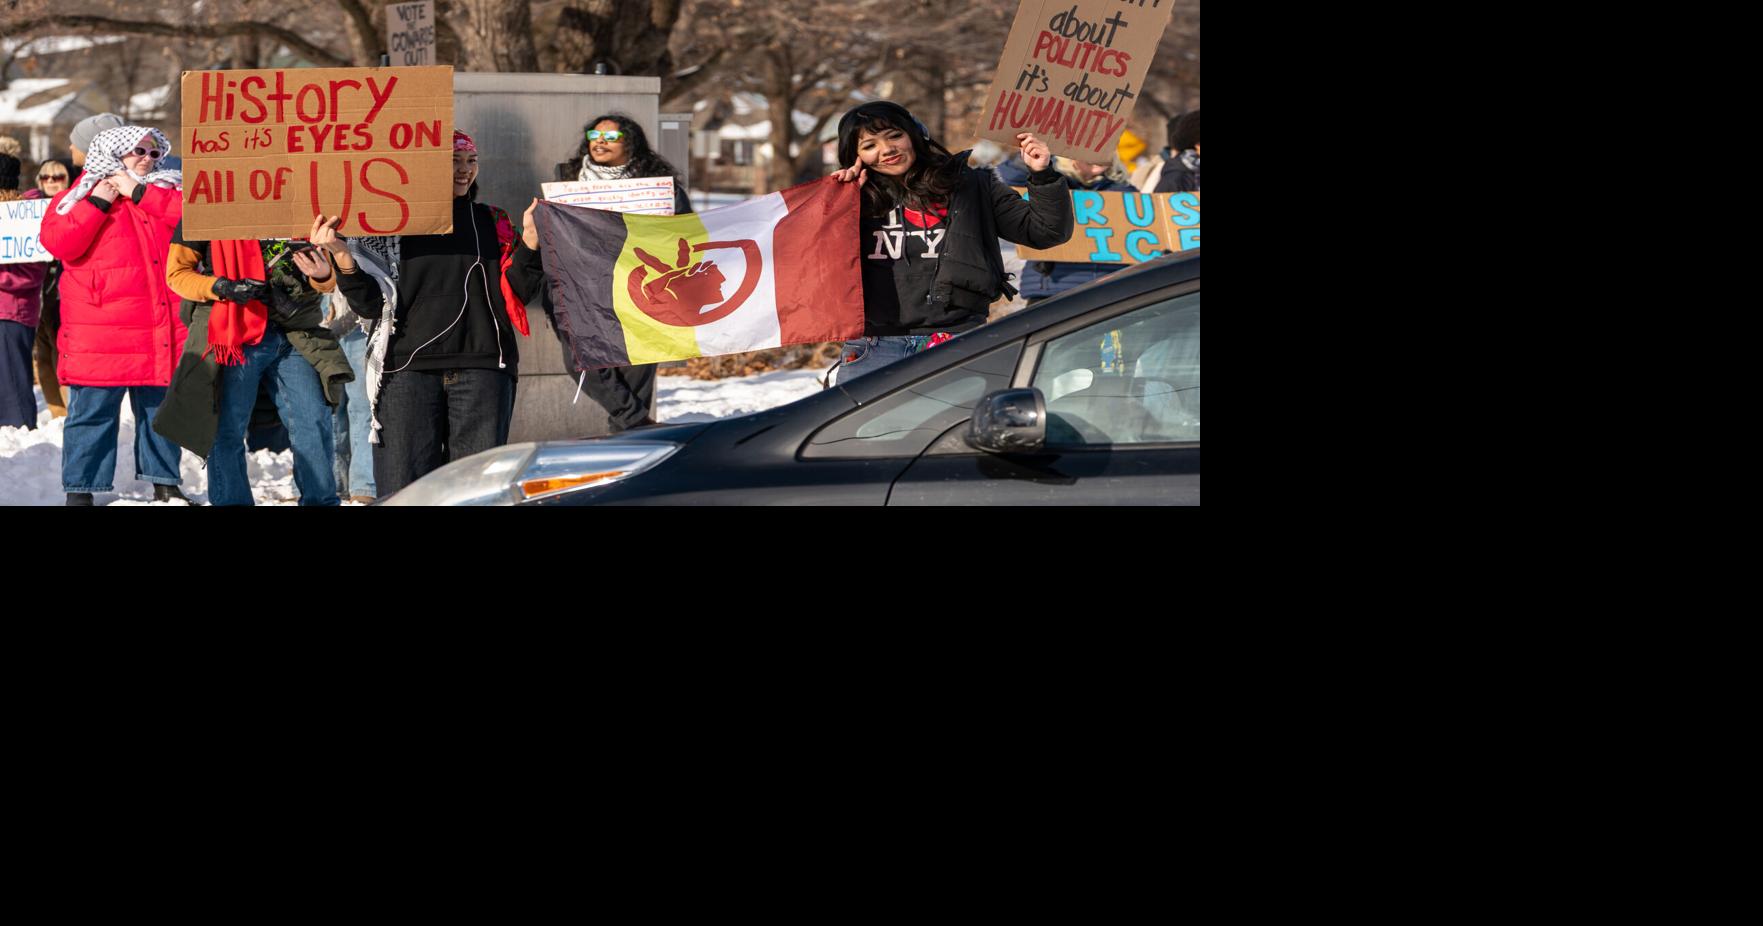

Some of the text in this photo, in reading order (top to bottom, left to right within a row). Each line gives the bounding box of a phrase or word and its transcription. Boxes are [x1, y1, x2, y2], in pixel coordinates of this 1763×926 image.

[396, 4, 426, 21] VOTE
[1049, 5, 1128, 47] about
[1033, 30, 1132, 77] POLITICS
[1016, 63, 1135, 114] it's about
[244, 127, 273, 149] it's
[287, 123, 373, 153] EYES
[389, 120, 442, 149] ON
[989, 90, 1125, 152] HUMANITY
[310, 157, 410, 234] US
[1022, 190, 1200, 227] RUS
[868, 229, 945, 259] NY
